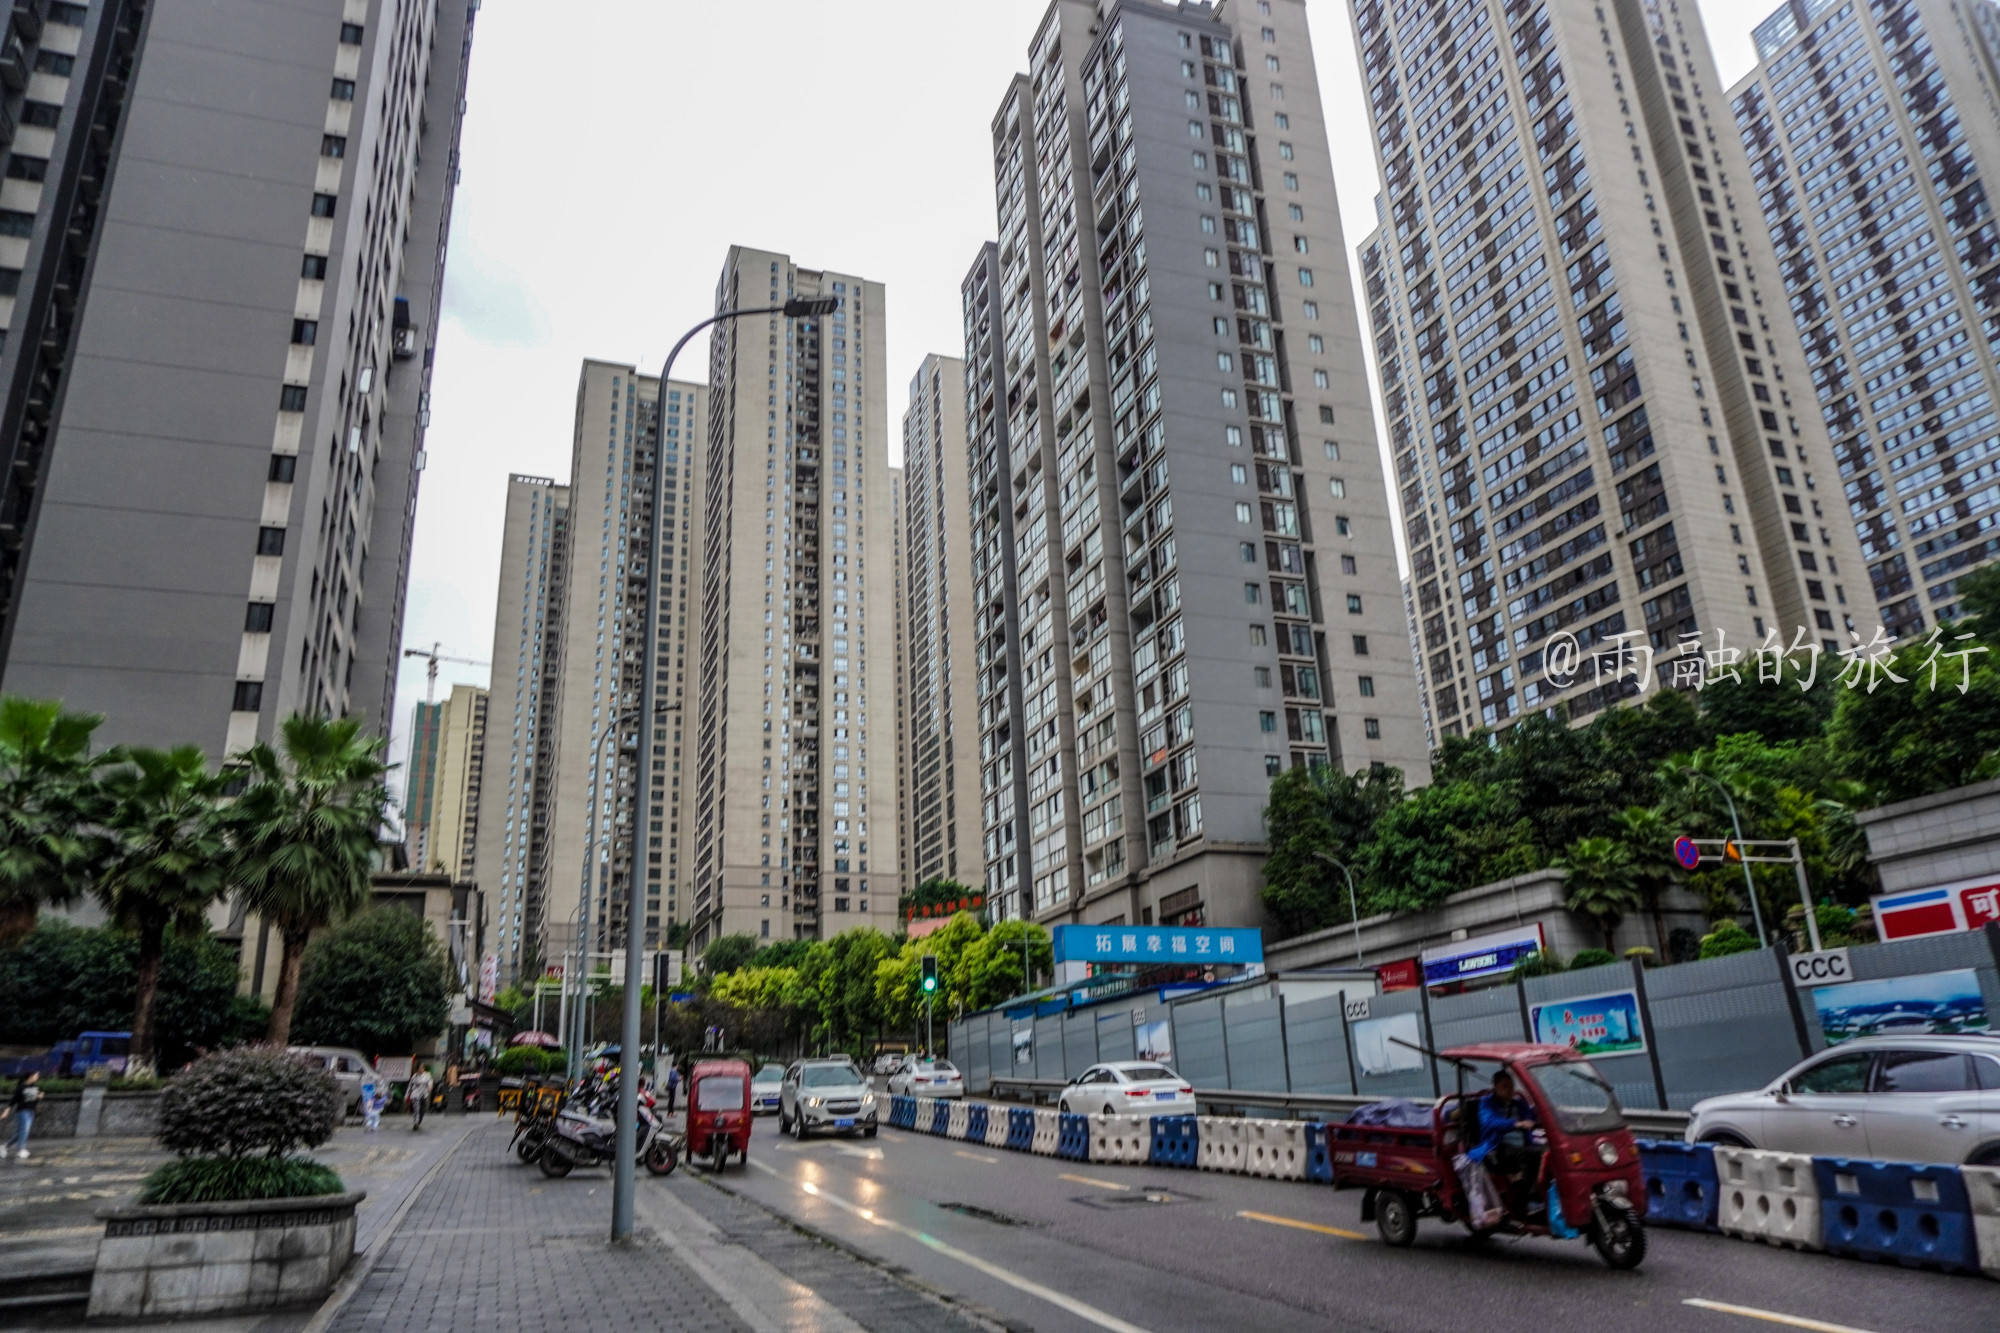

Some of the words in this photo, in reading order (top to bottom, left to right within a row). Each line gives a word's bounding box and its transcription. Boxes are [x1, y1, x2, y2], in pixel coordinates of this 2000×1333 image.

[1966, 888, 2000, 920] 可
[1095, 933, 1235, 954] 拓展幸福空间
[1795, 955, 1846, 980] CCC
[1346, 1001, 1367, 1018] CCC
